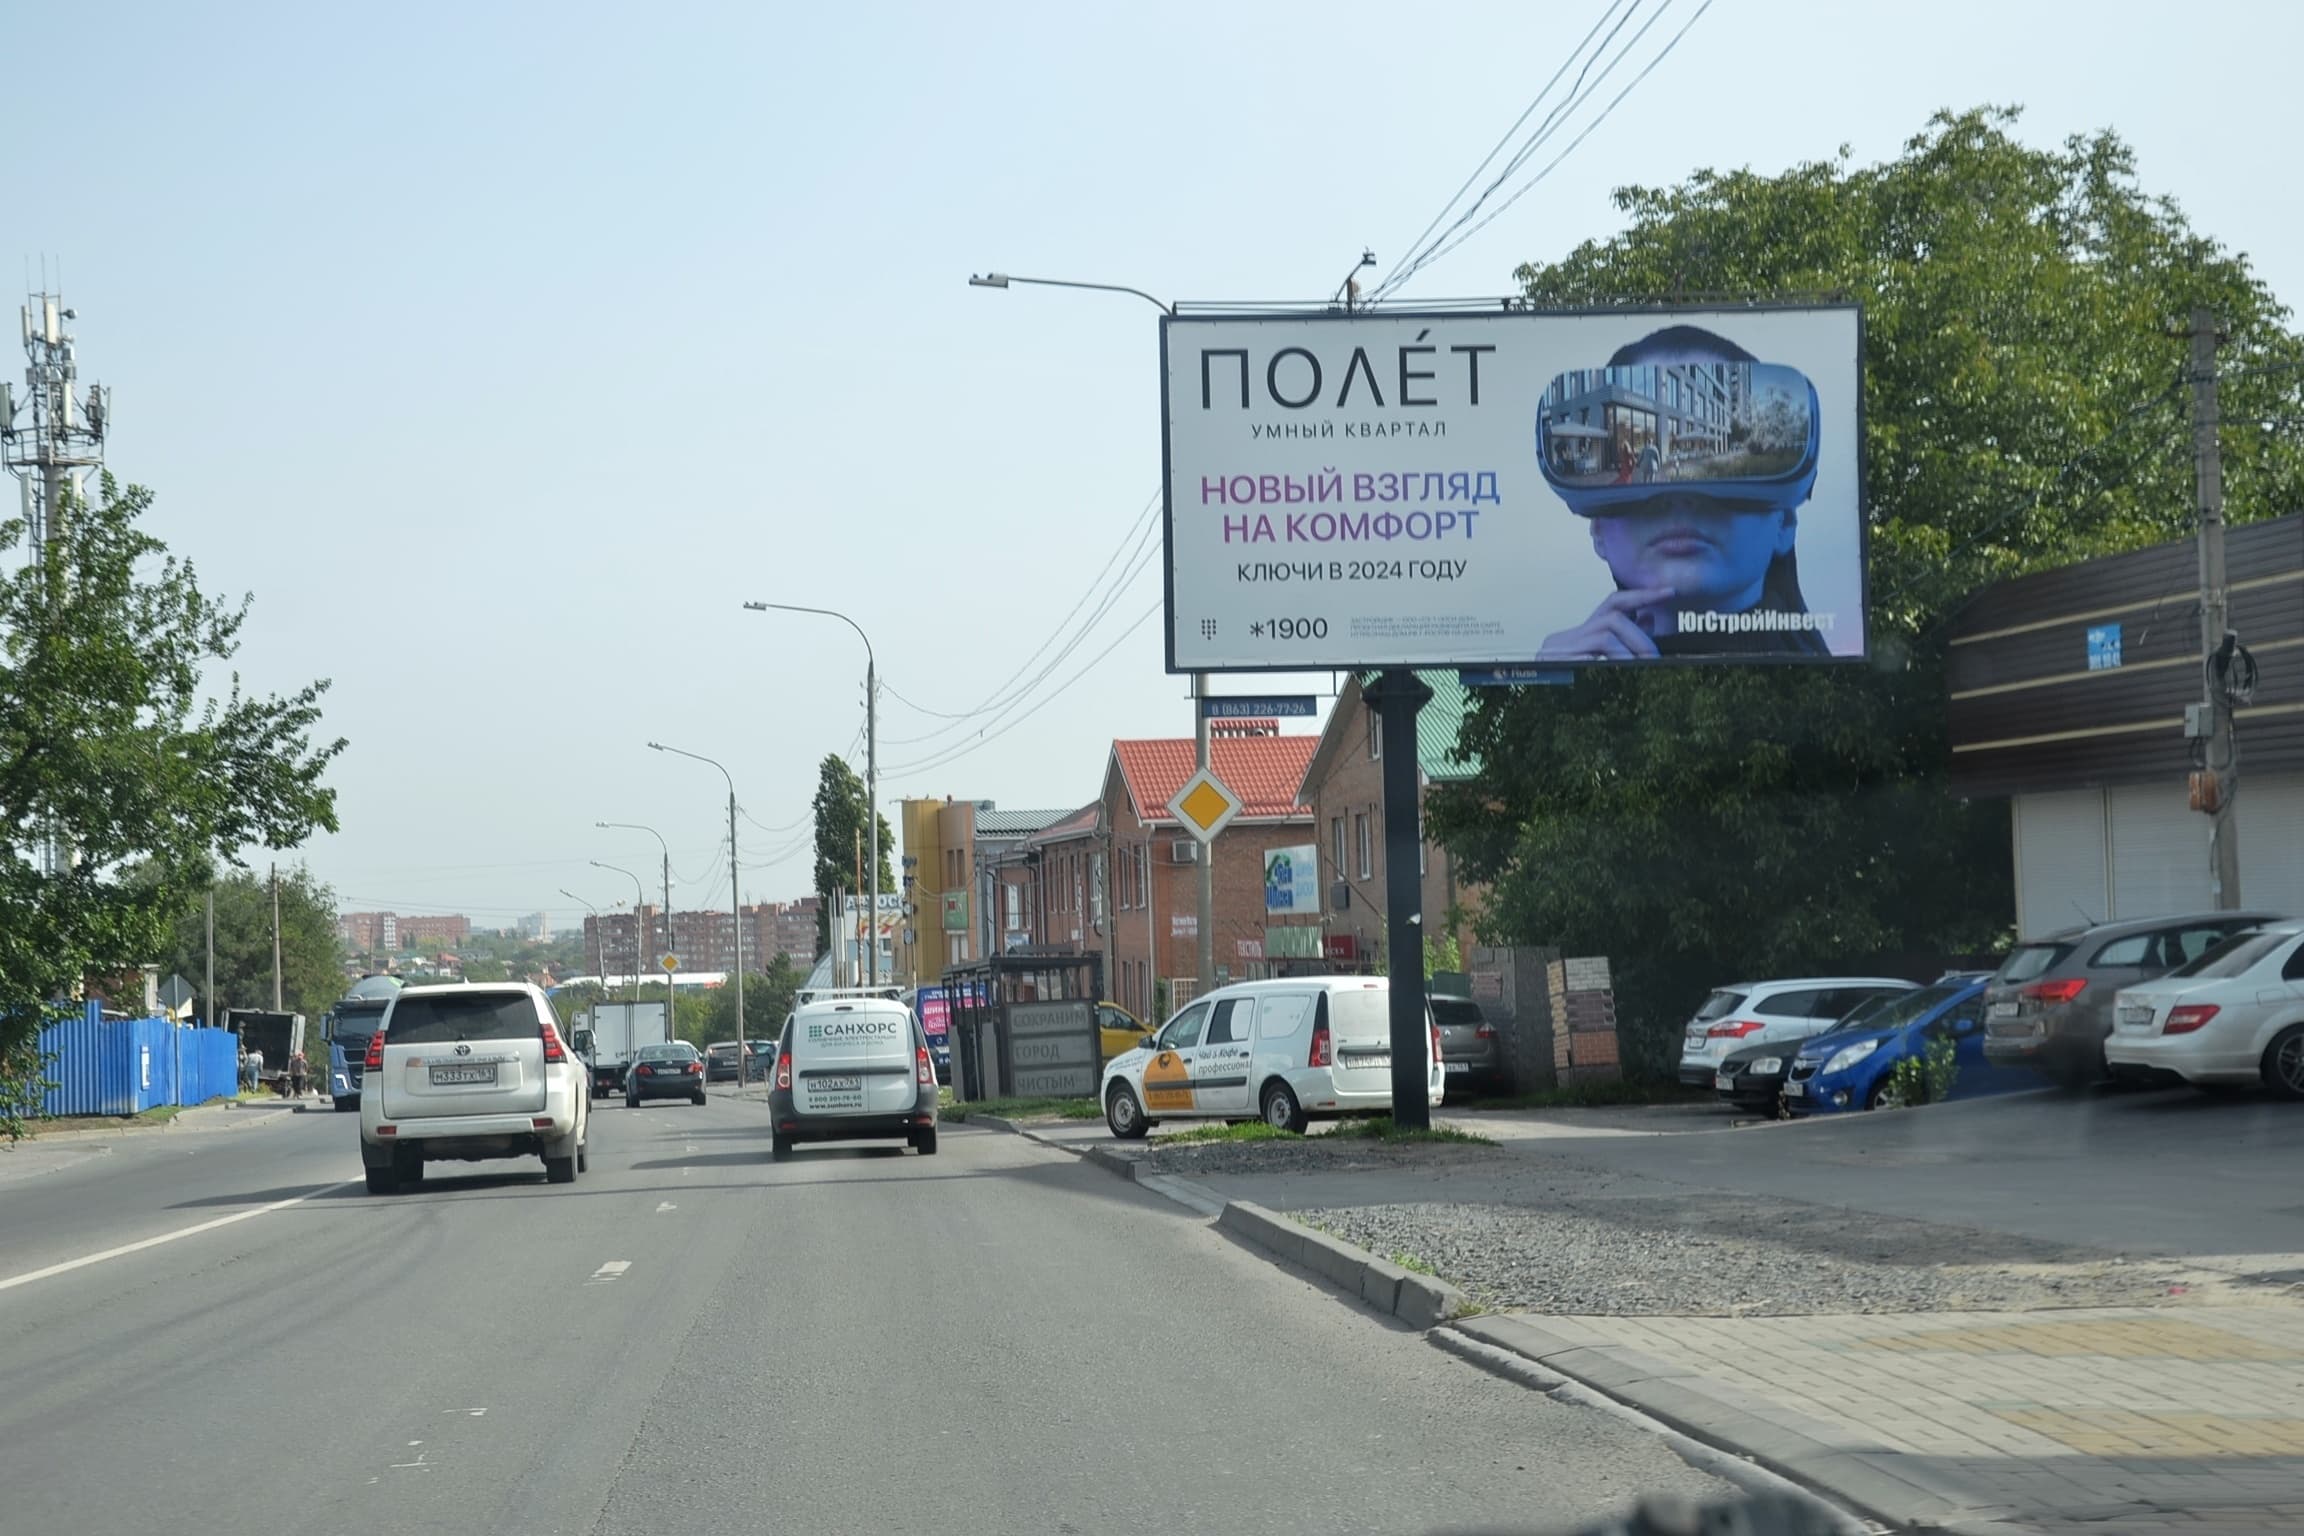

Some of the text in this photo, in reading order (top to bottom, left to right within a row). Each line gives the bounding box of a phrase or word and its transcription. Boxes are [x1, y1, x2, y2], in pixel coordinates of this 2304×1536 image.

[1252, 419, 1447, 439] УМНЫЙ КВАРТАЛ
[1201, 466, 1500, 505] НОВЫЙ ВЗГЛЯД
[1223, 510, 1480, 543] НА КОМФОРТ
[1238, 559, 1467, 582] КЛЮЧИ В 2024 ГОДУ
[1677, 608, 1836, 635] ЮгСтройИнвест
[1222, 703, 1250, 716] (863)
[1253, 702, 1306, 716] 226-77-26
[1013, 1009, 1087, 1027] СОХРАНИМ
[824, 1023, 896, 1036] САНХОРС
[1015, 1044, 1061, 1061] ГОРОД
[1017, 1073, 1076, 1091] ЧИСТЫМ
